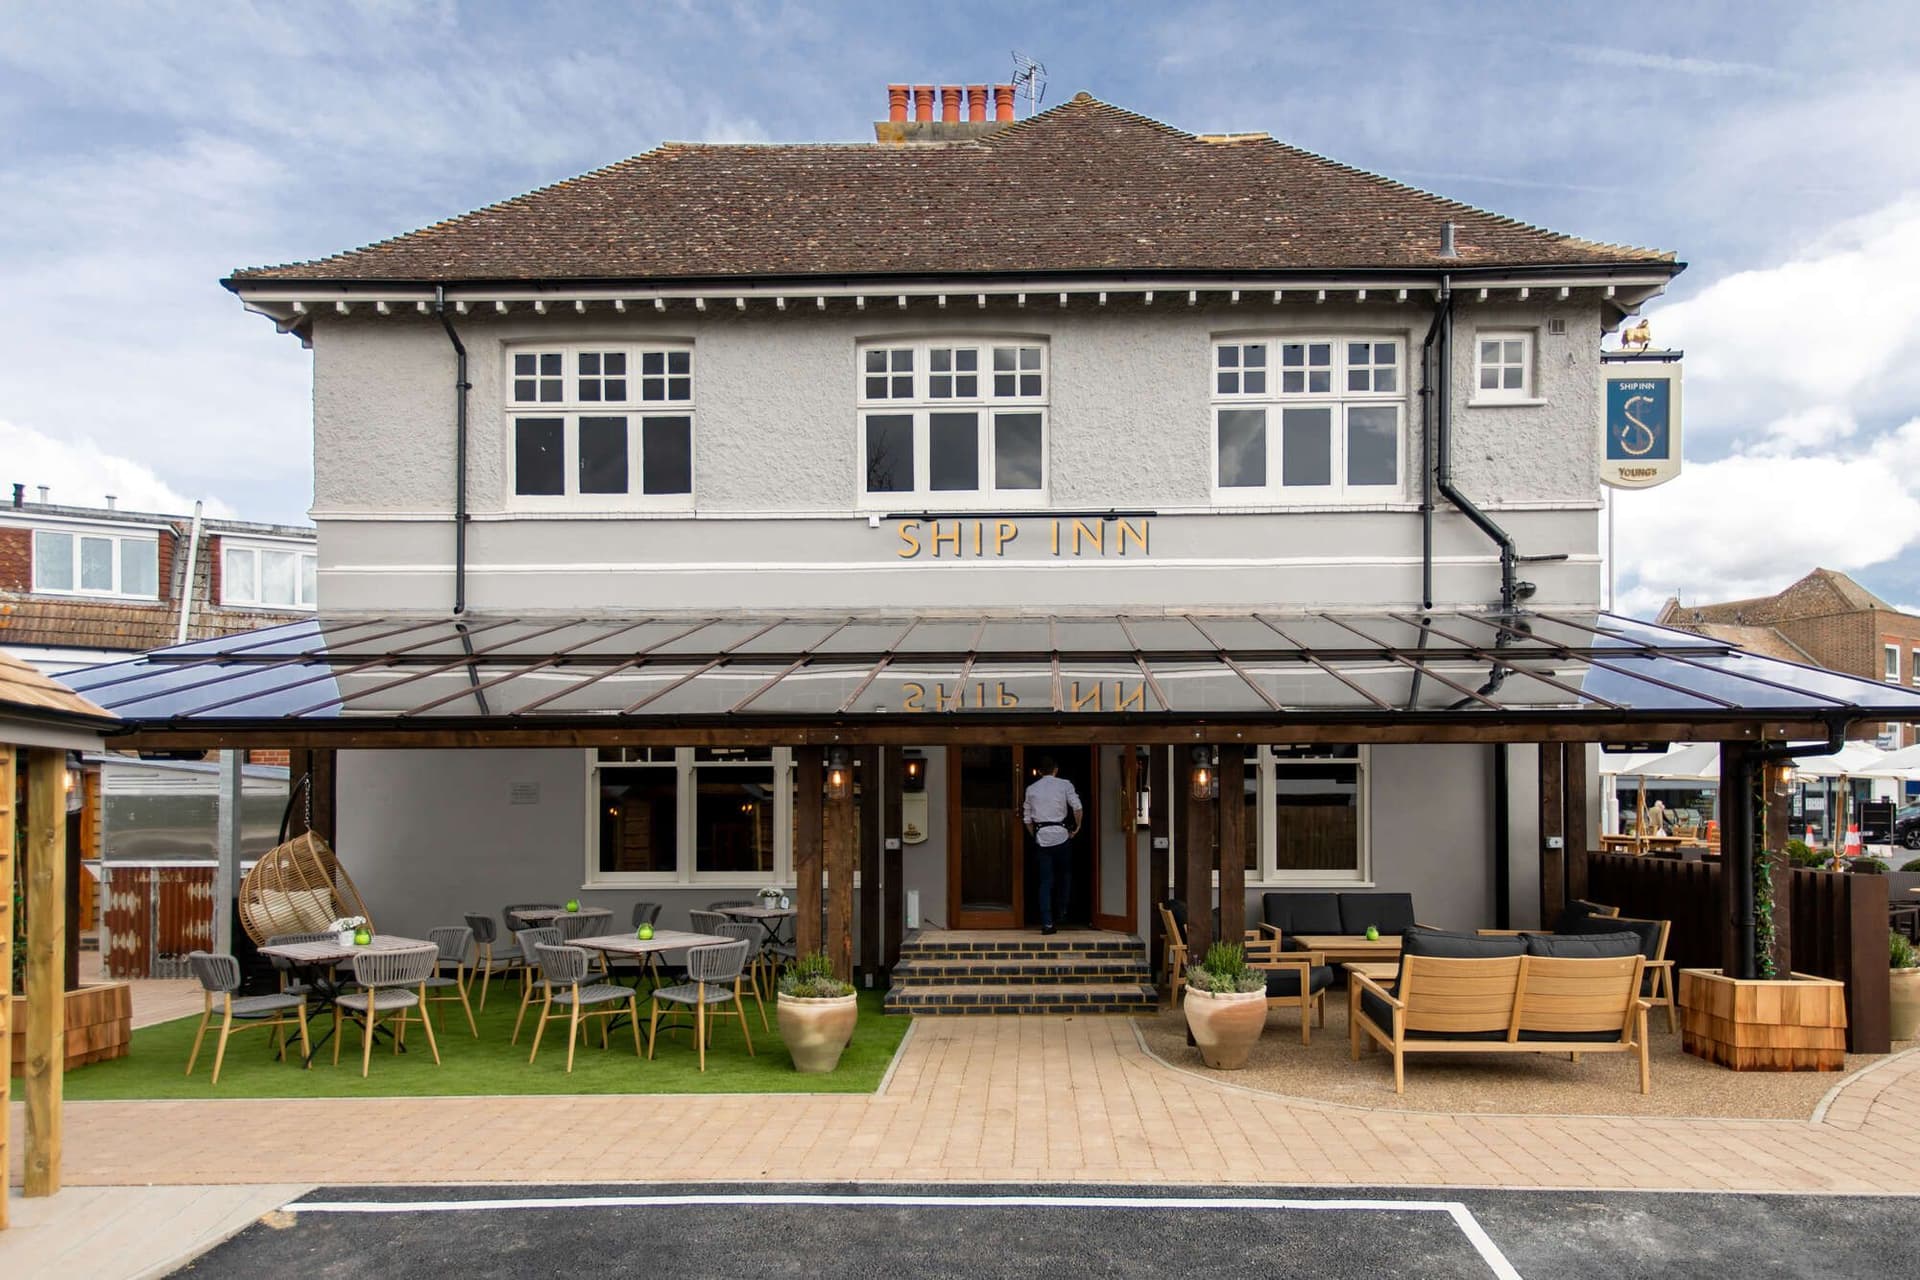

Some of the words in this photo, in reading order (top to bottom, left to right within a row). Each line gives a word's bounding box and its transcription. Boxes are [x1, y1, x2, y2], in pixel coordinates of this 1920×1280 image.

[1619, 382, 1639, 391] SHIP
[1639, 382, 1655, 391] INN
[897, 519, 1018, 558] SHIP
[1051, 519, 1149, 556] INN
